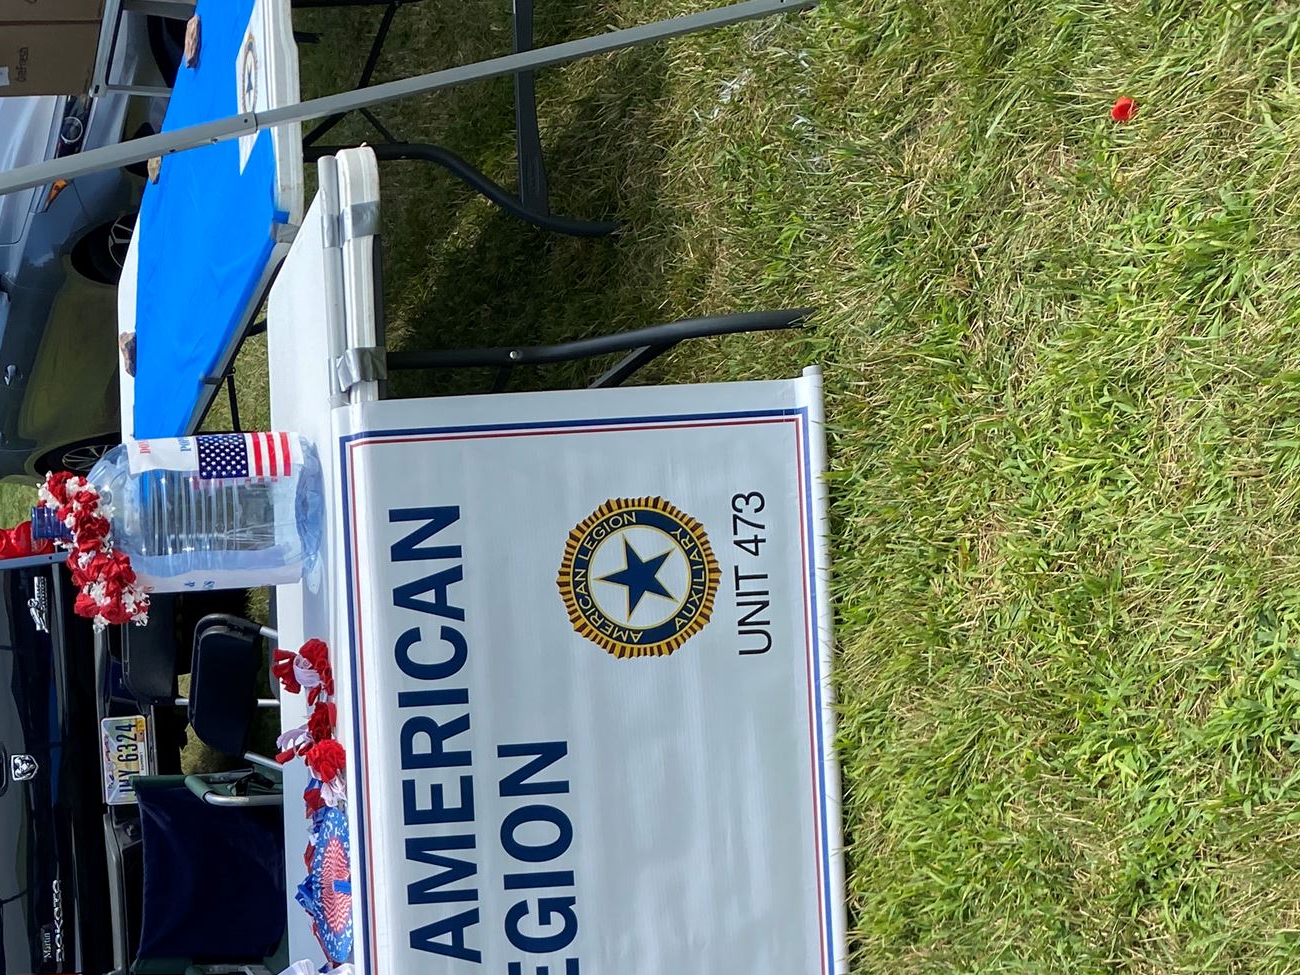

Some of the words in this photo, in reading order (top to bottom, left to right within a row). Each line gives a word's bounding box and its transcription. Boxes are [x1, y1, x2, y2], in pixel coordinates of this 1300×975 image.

[577, 512, 637, 560] LEGION
[731, 491, 766, 557] 473
[574, 568, 643, 643] AMERICAN
[670, 527, 705, 631] AUXILIARY
[734, 565, 772, 656] UNIT
[115, 724, 138, 762] 6324
[388, 505, 481, 964] AMERICAN
[52, 879, 65, 962] DAKOTA
